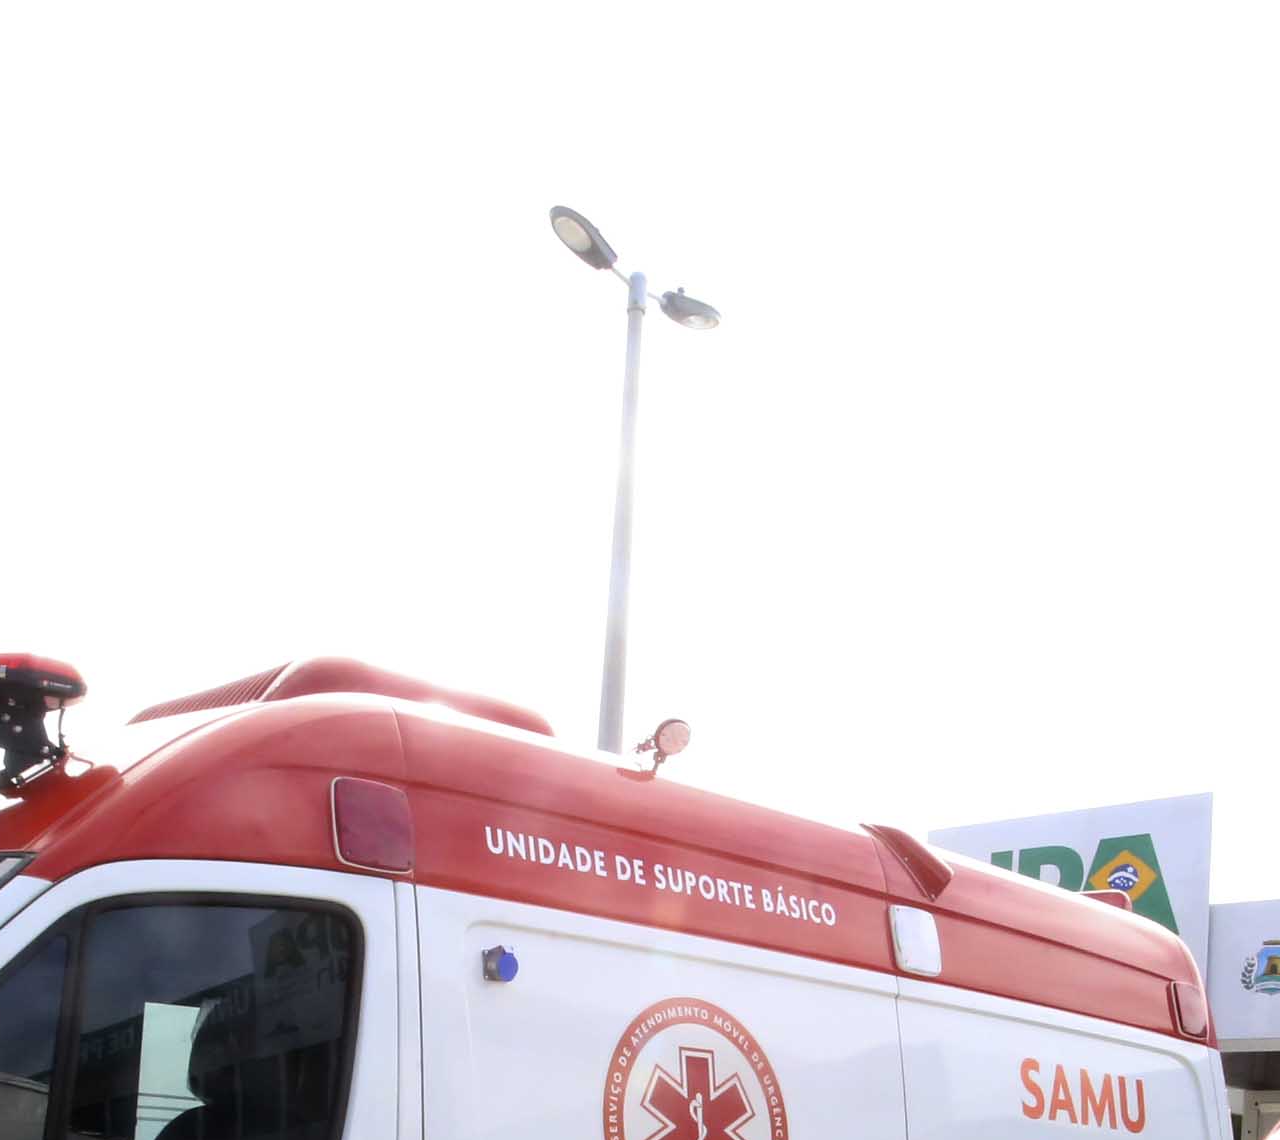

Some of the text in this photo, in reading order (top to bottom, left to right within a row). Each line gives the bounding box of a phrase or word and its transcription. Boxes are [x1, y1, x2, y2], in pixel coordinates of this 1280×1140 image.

[485, 826, 837, 927] UNIDADE DE SUPORTE BÁSICO
[618, 1046, 632, 1067] DE
[630, 1006, 709, 1047] ATENDIMENTO
[751, 1052, 765, 1070] DE
[1020, 1058, 1146, 1134] SAMU
